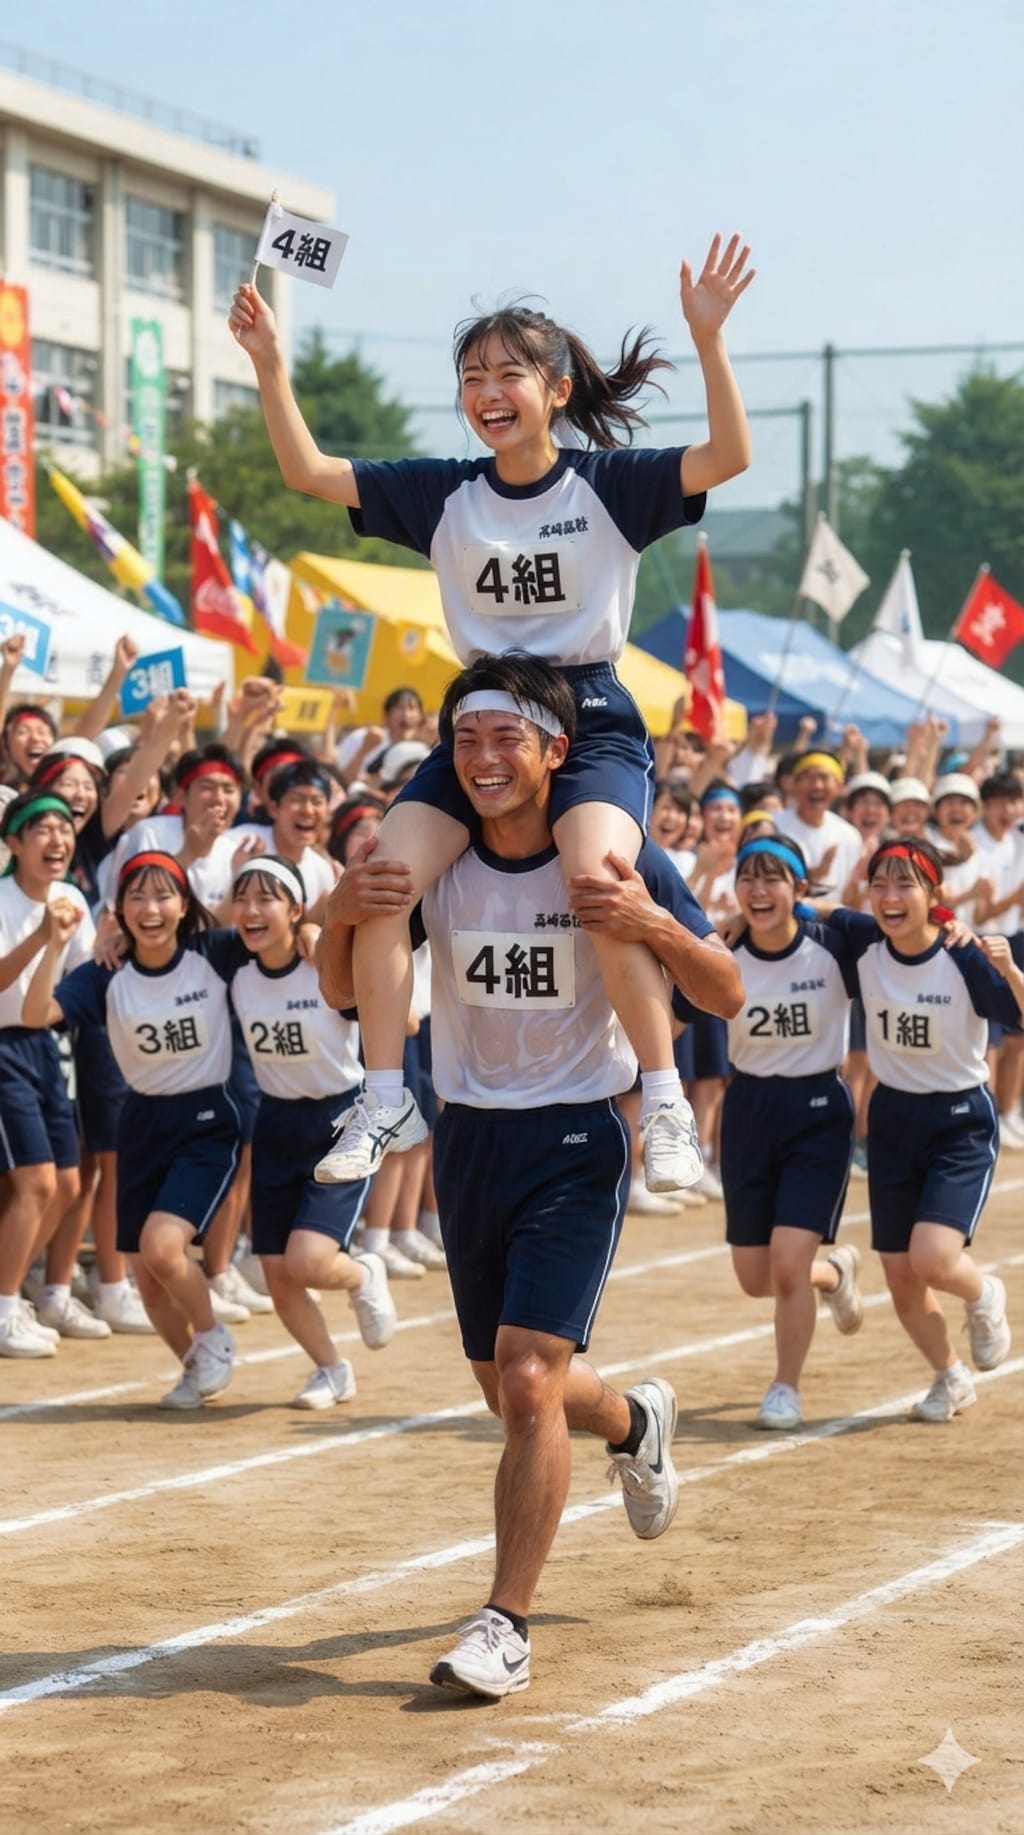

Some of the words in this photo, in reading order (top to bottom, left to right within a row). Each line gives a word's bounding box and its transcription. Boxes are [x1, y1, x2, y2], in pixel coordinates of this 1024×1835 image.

[271, 229, 332, 273] 4組
[475, 552, 566, 605] 4組
[465, 943, 559, 999] 4組
[135, 1016, 201, 1055] 3組
[250, 1021, 309, 1057] 2組
[747, 1002, 812, 1038] 2組
[877, 1009, 932, 1049] 1組
